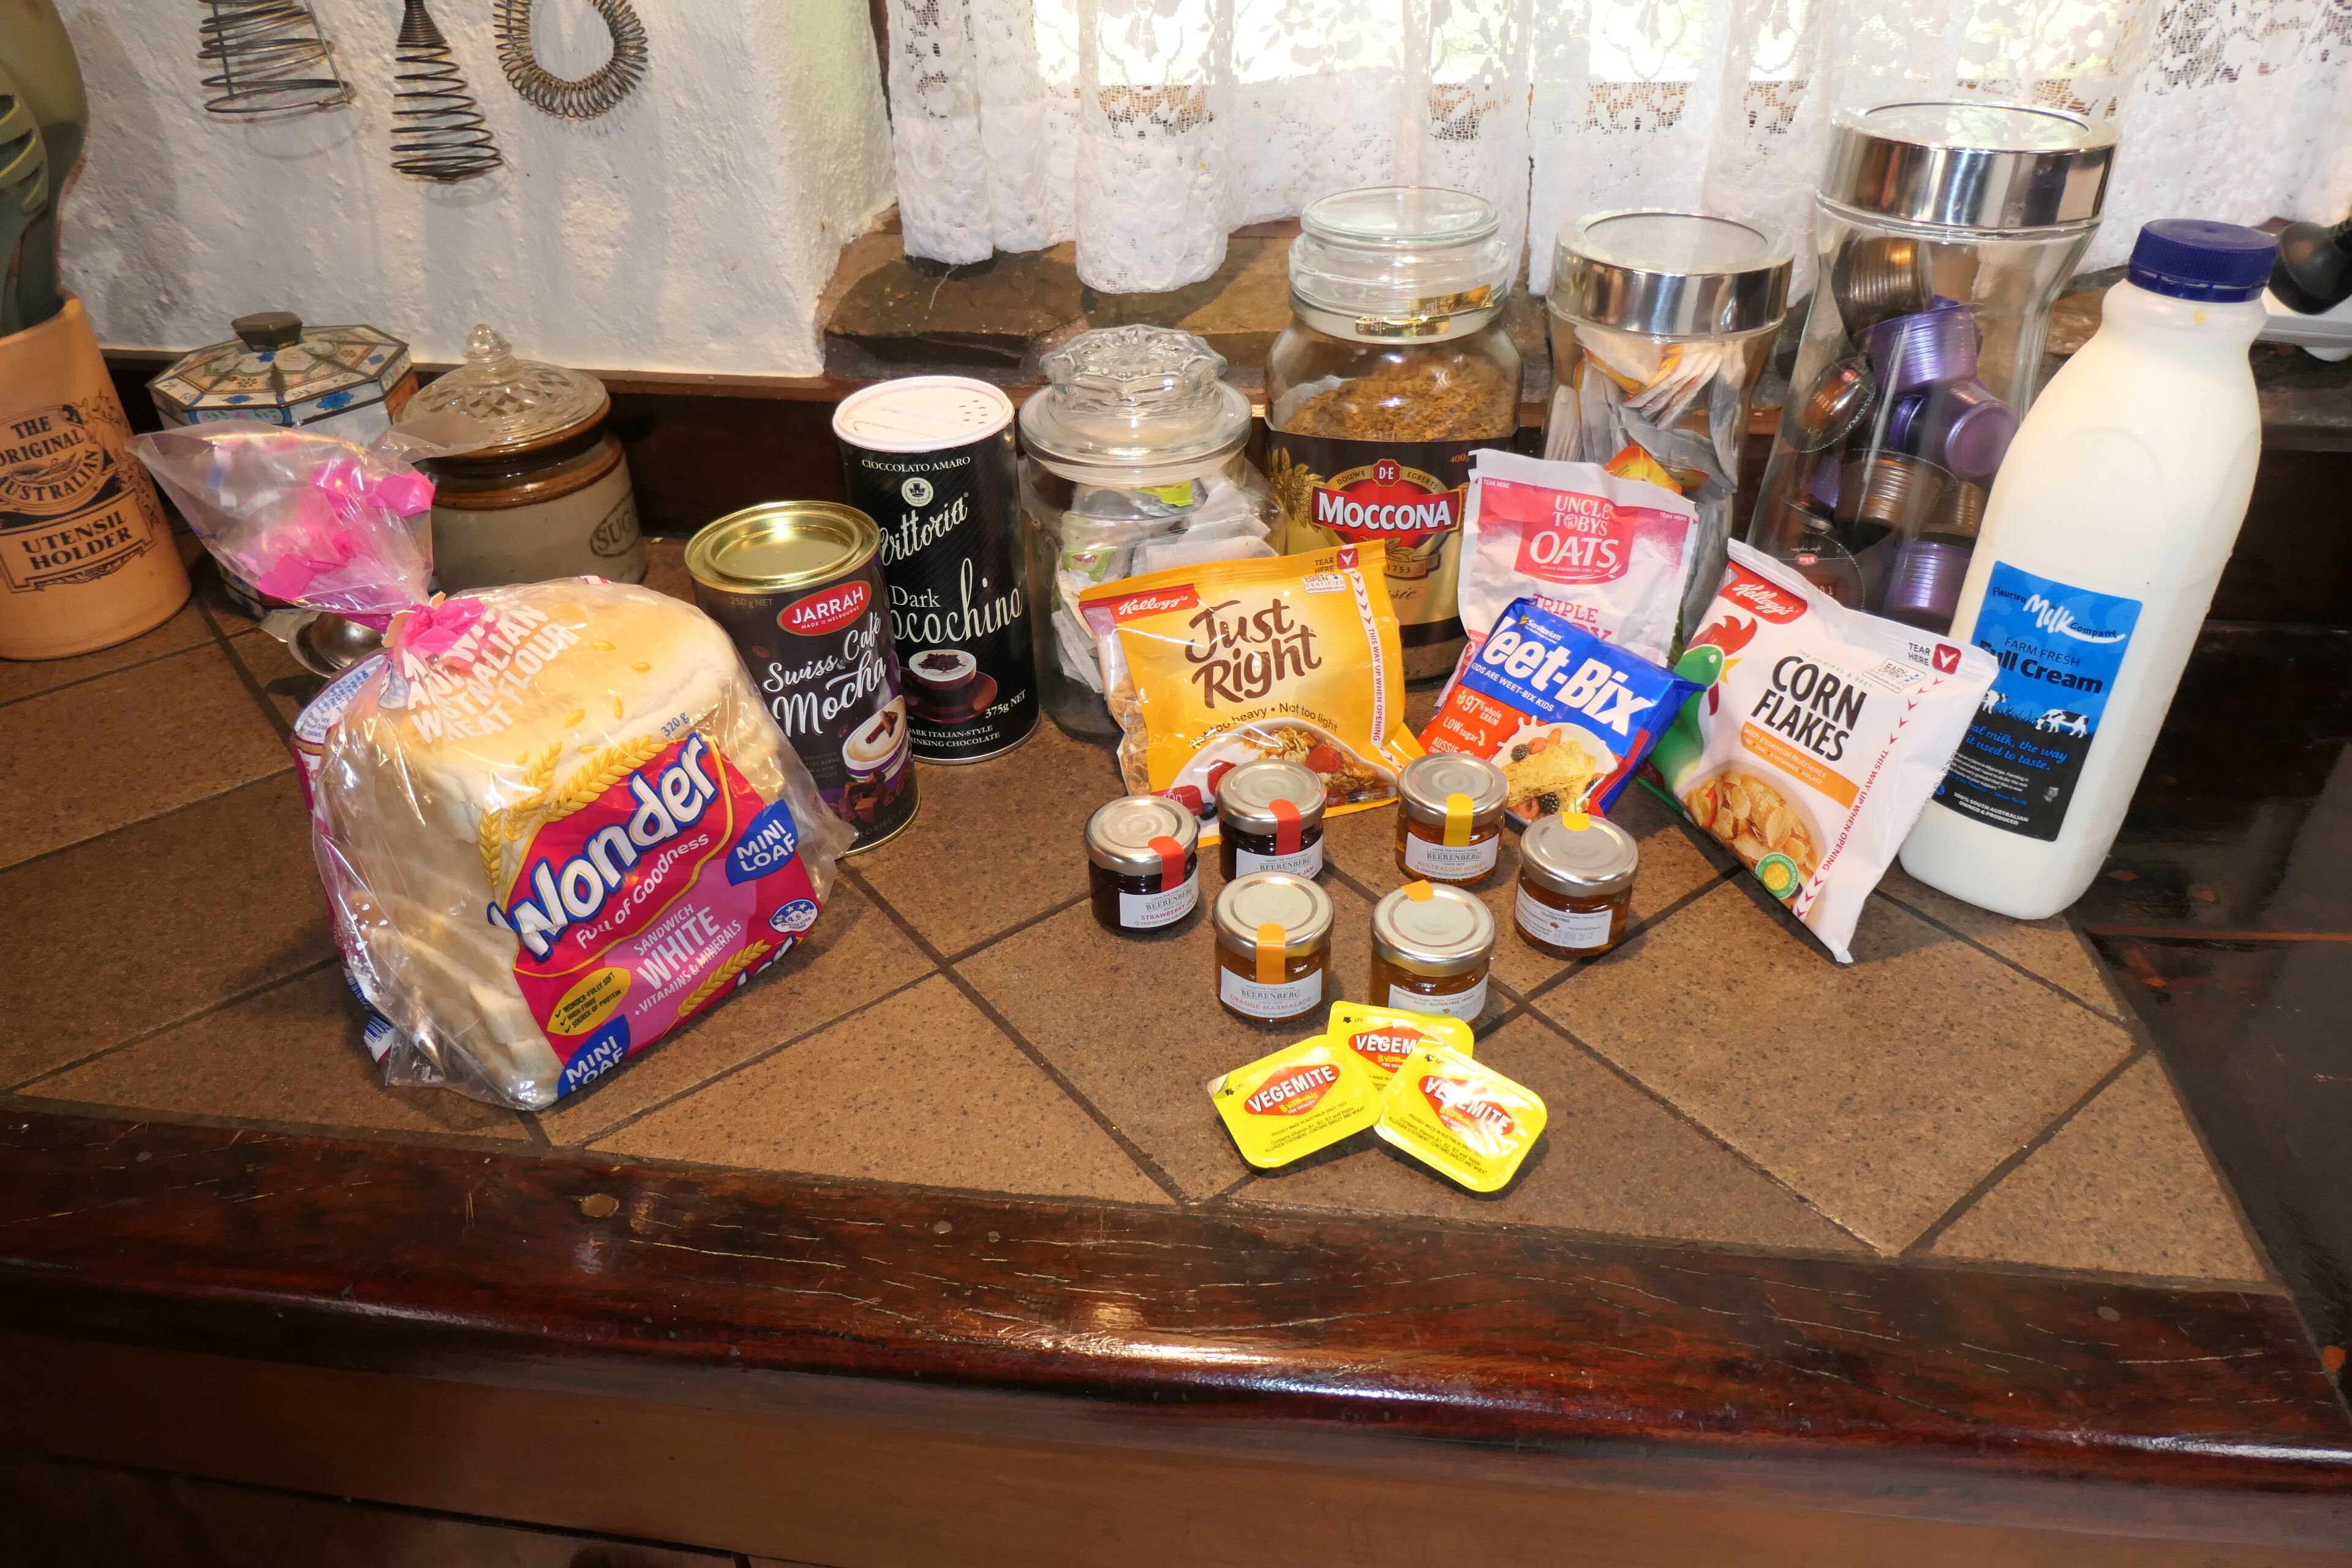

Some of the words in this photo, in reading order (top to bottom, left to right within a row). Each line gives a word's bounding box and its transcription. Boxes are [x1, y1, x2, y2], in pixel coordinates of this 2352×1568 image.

[9, 415, 52, 440] THE
[861, 459, 930, 473] CIOCCOLATO
[932, 456, 971, 472] AMARO
[1336, 470, 1366, 486] DOUWE
[1407, 471, 1439, 491] EGBERTS
[1483, 479, 1496, 488] TEAR
[1317, 492, 1452, 531] MOCCONA
[1555, 494, 1613, 521] UNCLE
[21, 510, 126, 554] UTENSIL
[880, 495, 968, 566] Vittoria
[1553, 511, 1608, 537] TOBYS
[29, 526, 133, 570] HOLDER
[1529, 530, 1620, 569] OATS
[1314, 557, 1335, 567] TEAR
[1314, 565, 1335, 574] HERE
[1387, 564, 1411, 574] 1753
[730, 597, 747, 606] 250
[755, 598, 773, 607] NET
[791, 586, 864, 625] JARRAH
[889, 585, 941, 608] Dark
[1117, 594, 1189, 616] Kellogg's
[1532, 592, 1599, 624] TRIPLE
[1732, 581, 1796, 617] Kellogg's
[1992, 587, 2027, 604] Fleurieu
[801, 621, 820, 630] MADE
[827, 605, 860, 623] MELBOURNE
[2022, 593, 2090, 638] Milk
[1184, 598, 1295, 664] Just
[1368, 628, 1378, 645] THIS
[1526, 619, 1562, 641] Sanitarium
[2070, 622, 2117, 639] Company
[763, 652, 838, 693] Swiss
[843, 612, 881, 662] Café
[1908, 642, 1931, 657] TEAR
[1908, 652, 1929, 666] HERE
[2004, 636, 2037, 657] FARM
[2040, 649, 2081, 667] FRESH
[497, 622, 580, 707] FLOUR
[1191, 624, 1323, 709] Right
[1375, 665, 1381, 676] UP
[2019, 658, 2104, 695] Cream
[773, 649, 886, 737] Mocha
[1484, 670, 1499, 682] ARE
[1498, 678, 1536, 704] WEET-BIX
[1534, 696, 1555, 713] KIDS
[1771, 655, 1868, 731] CORN
[984, 703, 1009, 720] 375g
[1010, 690, 1027, 707] NET
[1231, 707, 1268, 724] heavy
[1279, 702, 1299, 714] Not
[1300, 706, 1316, 720] too
[1317, 714, 1338, 733] light
[1483, 705, 1502, 720] whole
[660, 716, 681, 737] 320
[929, 725, 993, 738] ITALIAN-STYLE
[1373, 704, 1382, 741] OPENING
[1442, 715, 1463, 734] LOW
[1458, 728, 1479, 743] sugar
[1479, 711, 1499, 727] GRAIN
[1751, 688, 1852, 762] FLAKES
[911, 736, 944, 747] RINKING
[946, 731, 1001, 747] CHOCOLATE
[1431, 736, 1460, 754] AUSSIE
[1969, 723, 1987, 736] eal
[1985, 731, 2015, 748] milk,
[2019, 741, 2038, 753] the
[2040, 748, 2068, 764] way
[1760, 735, 1791, 758] Essential
[1791, 754, 1828, 778] Nutrients
[1874, 750, 1890, 771] THIS
[1966, 735, 1975, 745] it
[1976, 741, 2003, 756] used
[2004, 750, 2016, 760] to
[2018, 754, 2051, 771] taste.
[1864, 771, 1878, 791] WAY
[1858, 791, 1868, 805] UP
[1969, 799, 1990, 809] SOUTH
[1989, 805, 2029, 823] AUSTRALIAN
[1844, 805, 1861, 832] WHEN
[1958, 800, 1980, 813] OWNED
[1985, 812, 2019, 826] PRODUCED
[488, 734, 715, 956] Wonder
[736, 819, 787, 861] MINI
[1822, 832, 1848, 872] OPENING
[740, 836, 797, 872] LOAF
[1260, 856, 1312, 872] BEERENBERG
[1417, 861, 1462, 872] AUSTRALIAN
[1427, 852, 1482, 861] BEERENBERG
[1145, 886, 1193, 911] BEERENBERG
[1141, 903, 1185, 921] STRAWBERRY
[633, 903, 695, 956] SANDWICH
[636, 907, 720, 990] WHITE
[639, 970, 692, 1012] VITAMINS
[695, 919, 742, 969] MINERALS
[562, 982, 603, 1014] WONDER-FULLY
[602, 971, 616, 986] SOFT
[1229, 993, 1261, 1010] ORANGE
[1263, 995, 1313, 1011] MARMALADE
[1240, 989, 1300, 1000] BEERENBERG
[567, 1008, 582, 1021] HIGH
[581, 997, 598, 1011] FIBRE
[571, 1009, 592, 1028] SOURCE
[591, 1004, 598, 1012] OF
[598, 989, 622, 1007] PROTEIN
[1355, 1035, 1418, 1055] VEGEM
[565, 1035, 618, 1085] MINI
[1248, 1065, 1338, 1114] VEGEMITE
[1297, 1099, 1316, 1112] VITALITY
[1265, 1142, 1286, 1153] ALLERGEN
[1309, 1123, 1329, 1134] CONTAINS
[1328, 1117, 1343, 1128] BARLEY
[1343, 1112, 1352, 1120] AND
[1351, 1105, 1366, 1116] WHEAT
[1270, 1126, 1289, 1137] PROUDLY
[1288, 1121, 1300, 1130] MADE
[1305, 1110, 1325, 1123] AUSTRALIA
[1325, 1105, 1338, 1114] SINCE
[1270, 1136, 1291, 1145] Contains
[1291, 1127, 1308, 1137] Vitamin
